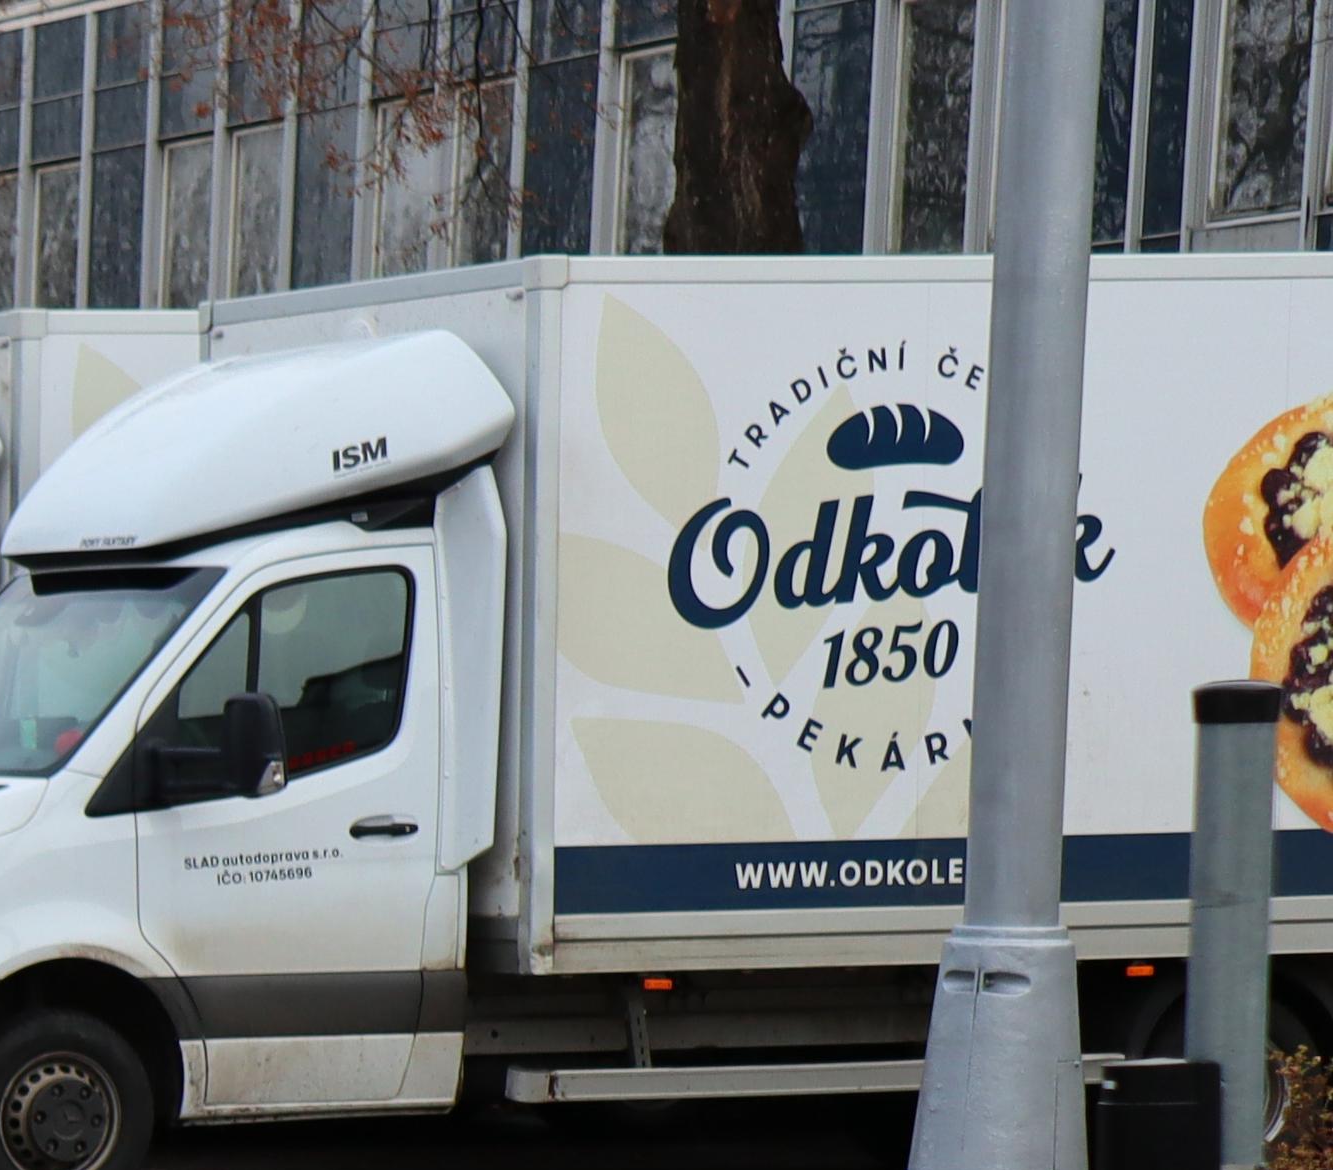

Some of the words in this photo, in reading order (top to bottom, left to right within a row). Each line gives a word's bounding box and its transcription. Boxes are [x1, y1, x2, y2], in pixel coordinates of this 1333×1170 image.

[727, 339, 907, 473] TRADIČNÍ
[333, 436, 388, 471] ISM
[668, 472, 1116, 629] Odkolk
[822, 618, 960, 690] 1850
[184, 856, 219, 871] SLAD
[222, 850, 309, 868] autodoprava
[312, 847, 343, 860] s.r.o.
[249, 866, 313, 883] 10745696
[735, 857, 964, 890] WWW.ODKOLE
